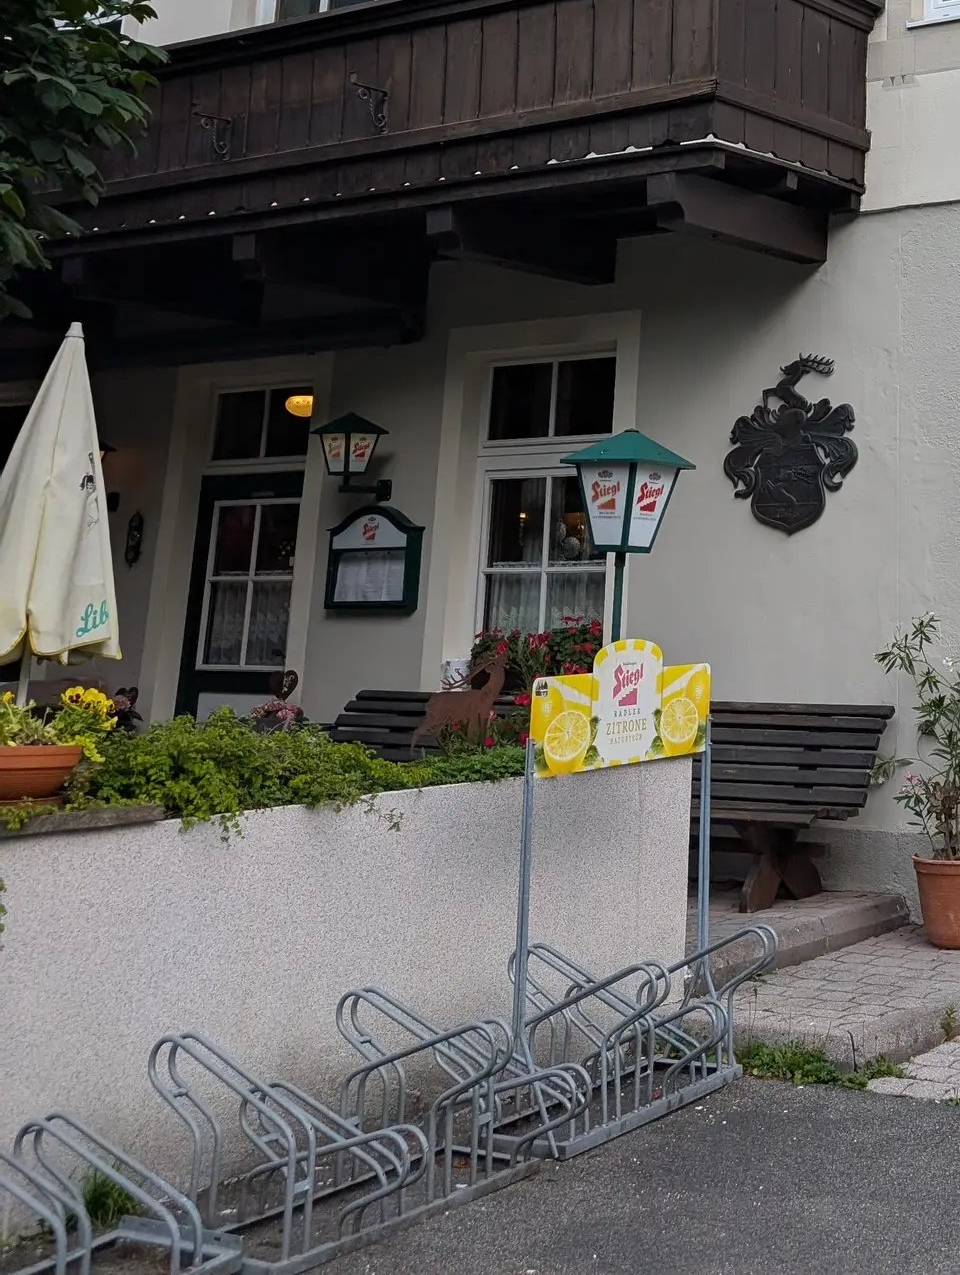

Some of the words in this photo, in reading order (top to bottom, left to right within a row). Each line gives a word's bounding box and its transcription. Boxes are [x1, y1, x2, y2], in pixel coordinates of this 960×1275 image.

[592, 479, 620, 504] Stiegl
[636, 481, 665, 506] Stiegl
[612, 662, 644, 700] Stiegl
[613, 707, 641, 718] RADLER
[606, 717, 648, 736] ZITRONE
